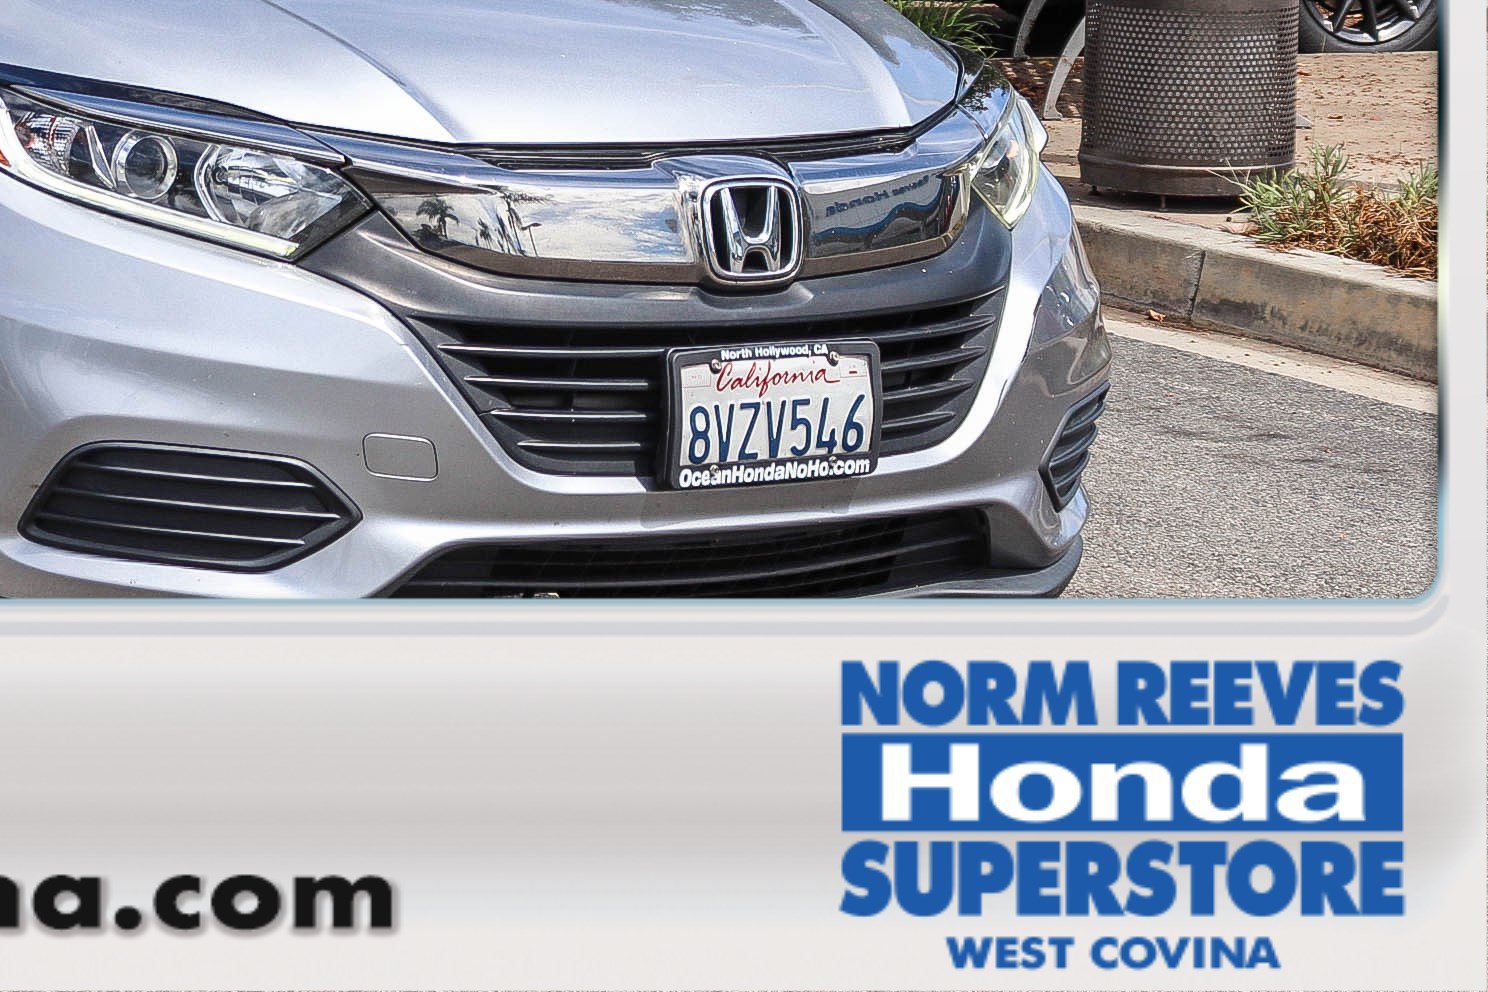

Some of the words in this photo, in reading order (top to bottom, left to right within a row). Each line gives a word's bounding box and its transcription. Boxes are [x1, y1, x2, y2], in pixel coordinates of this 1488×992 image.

[720, 346, 752, 361] North
[754, 344, 812, 359] Hollywood,
[813, 343, 829, 355] CA
[715, 361, 841, 398] California
[687, 393, 866, 465] 8VZV546
[678, 457, 871, 489] OceanHondaNoHo.com
